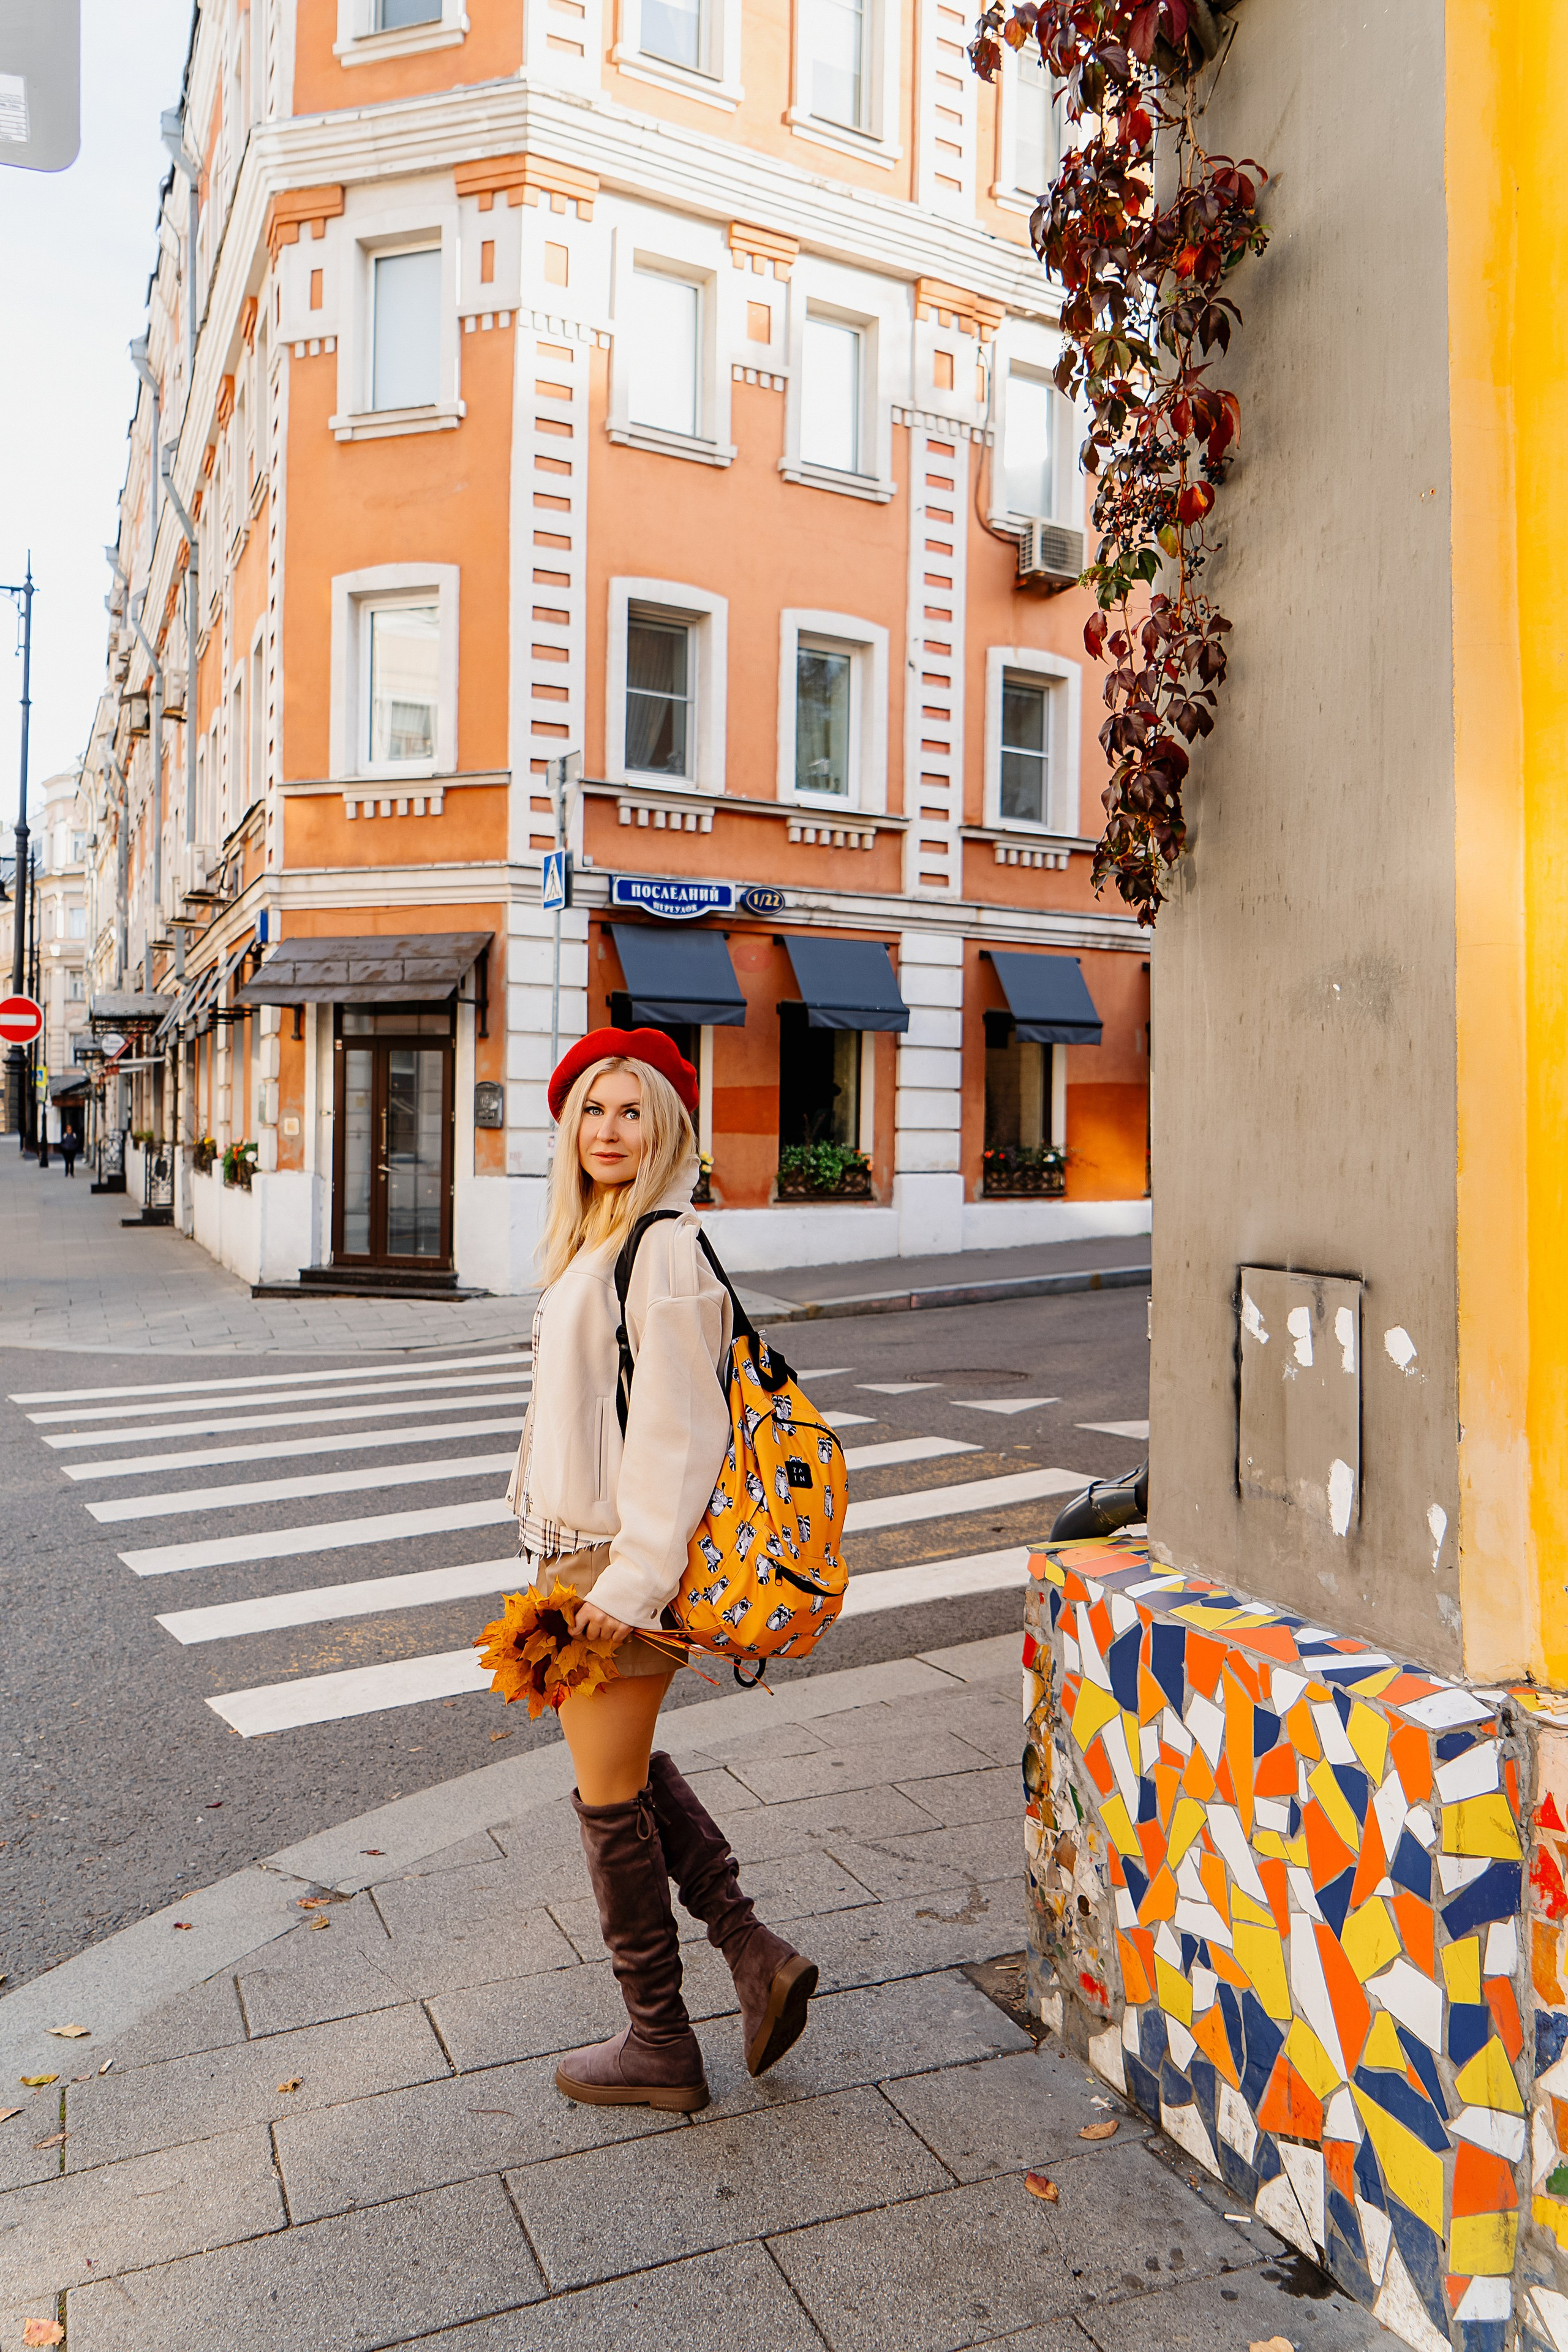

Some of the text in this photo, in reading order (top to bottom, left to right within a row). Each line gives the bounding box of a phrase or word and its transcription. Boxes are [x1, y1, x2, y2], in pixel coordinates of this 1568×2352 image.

[631, 884, 719, 902] ПОСЛЕДНИЙ
[754, 893, 780, 907] 1/22
[653, 901, 698, 913] ПЕРЕУЛОК
